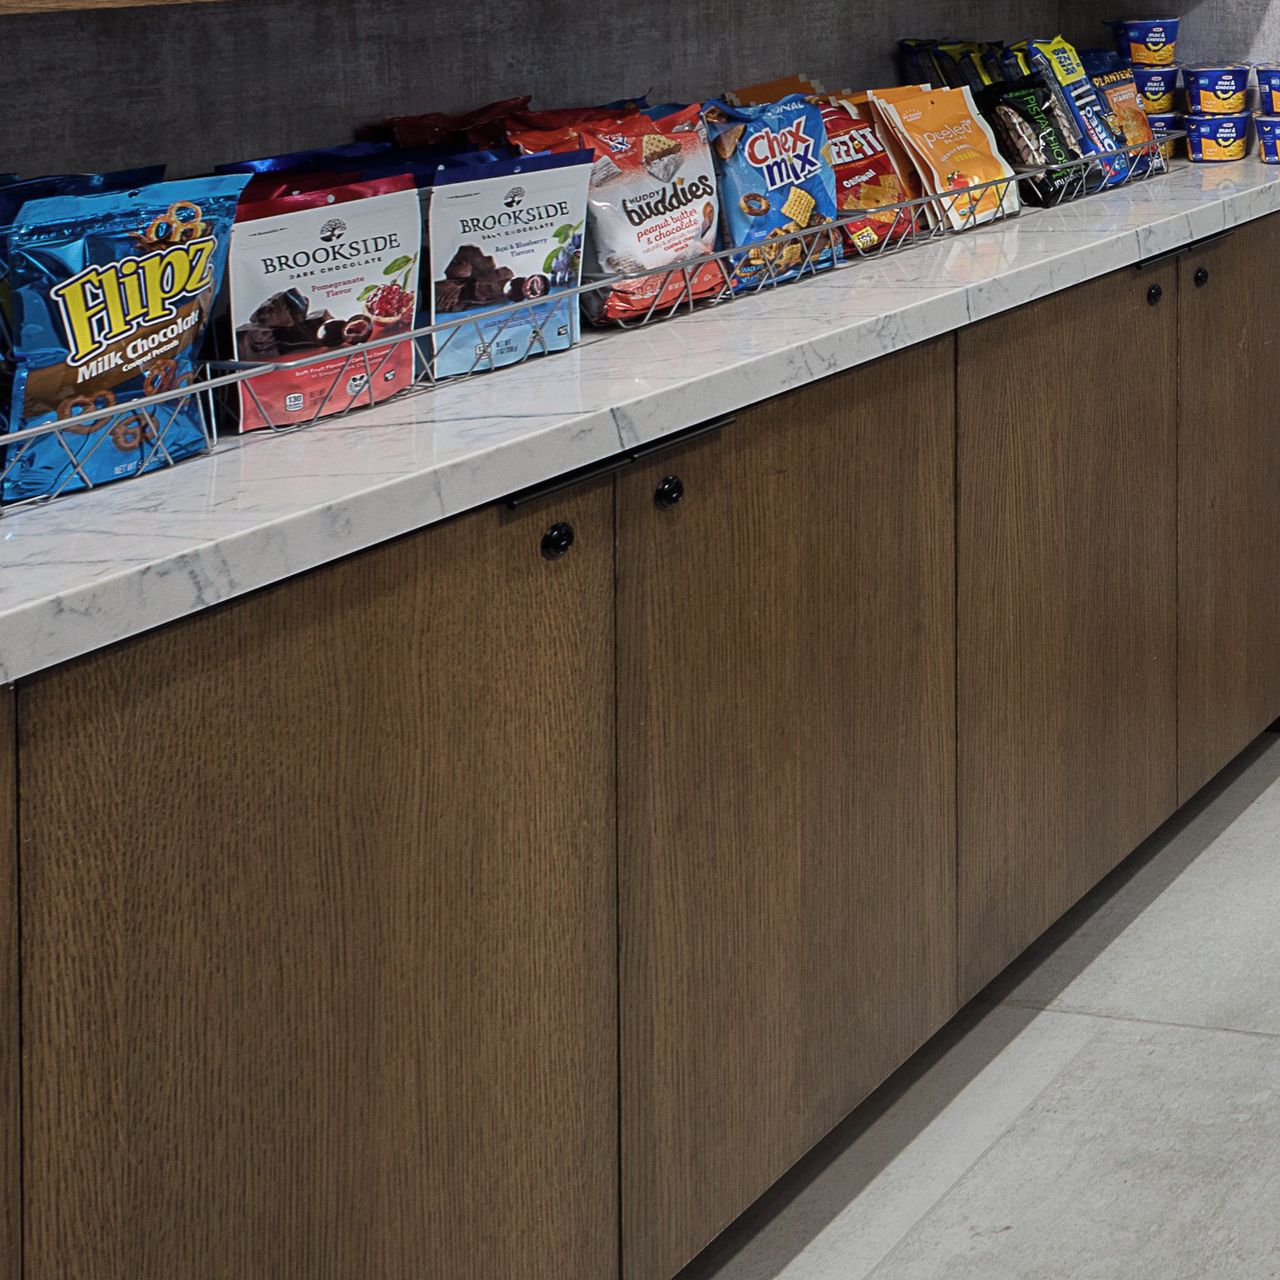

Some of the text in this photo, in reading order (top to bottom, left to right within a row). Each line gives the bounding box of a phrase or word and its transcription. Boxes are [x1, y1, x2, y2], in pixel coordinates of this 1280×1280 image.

[745, 115, 815, 166] Chex
[1085, 105, 1118, 152] OREO
[621, 174, 715, 227] buddies
[627, 189, 662, 204] MUDDY
[458, 201, 570, 234] BROOKSIDE
[505, 221, 555, 236] CHOCOLATE
[636, 219, 671, 243] peanut
[669, 208, 698, 225] butter
[653, 218, 699, 242] chocolate
[261, 232, 401, 275] BROOKSIDE
[515, 237, 548, 250] Blueberry
[289, 256, 383, 280] DARK CHOCOLATE
[311, 275, 365, 293] Pomegranate
[325, 286, 352, 298] Flavor
[57, 237, 216, 363] Flipz
[76, 350, 125, 384] Milk
[122, 353, 152, 372] Covered
